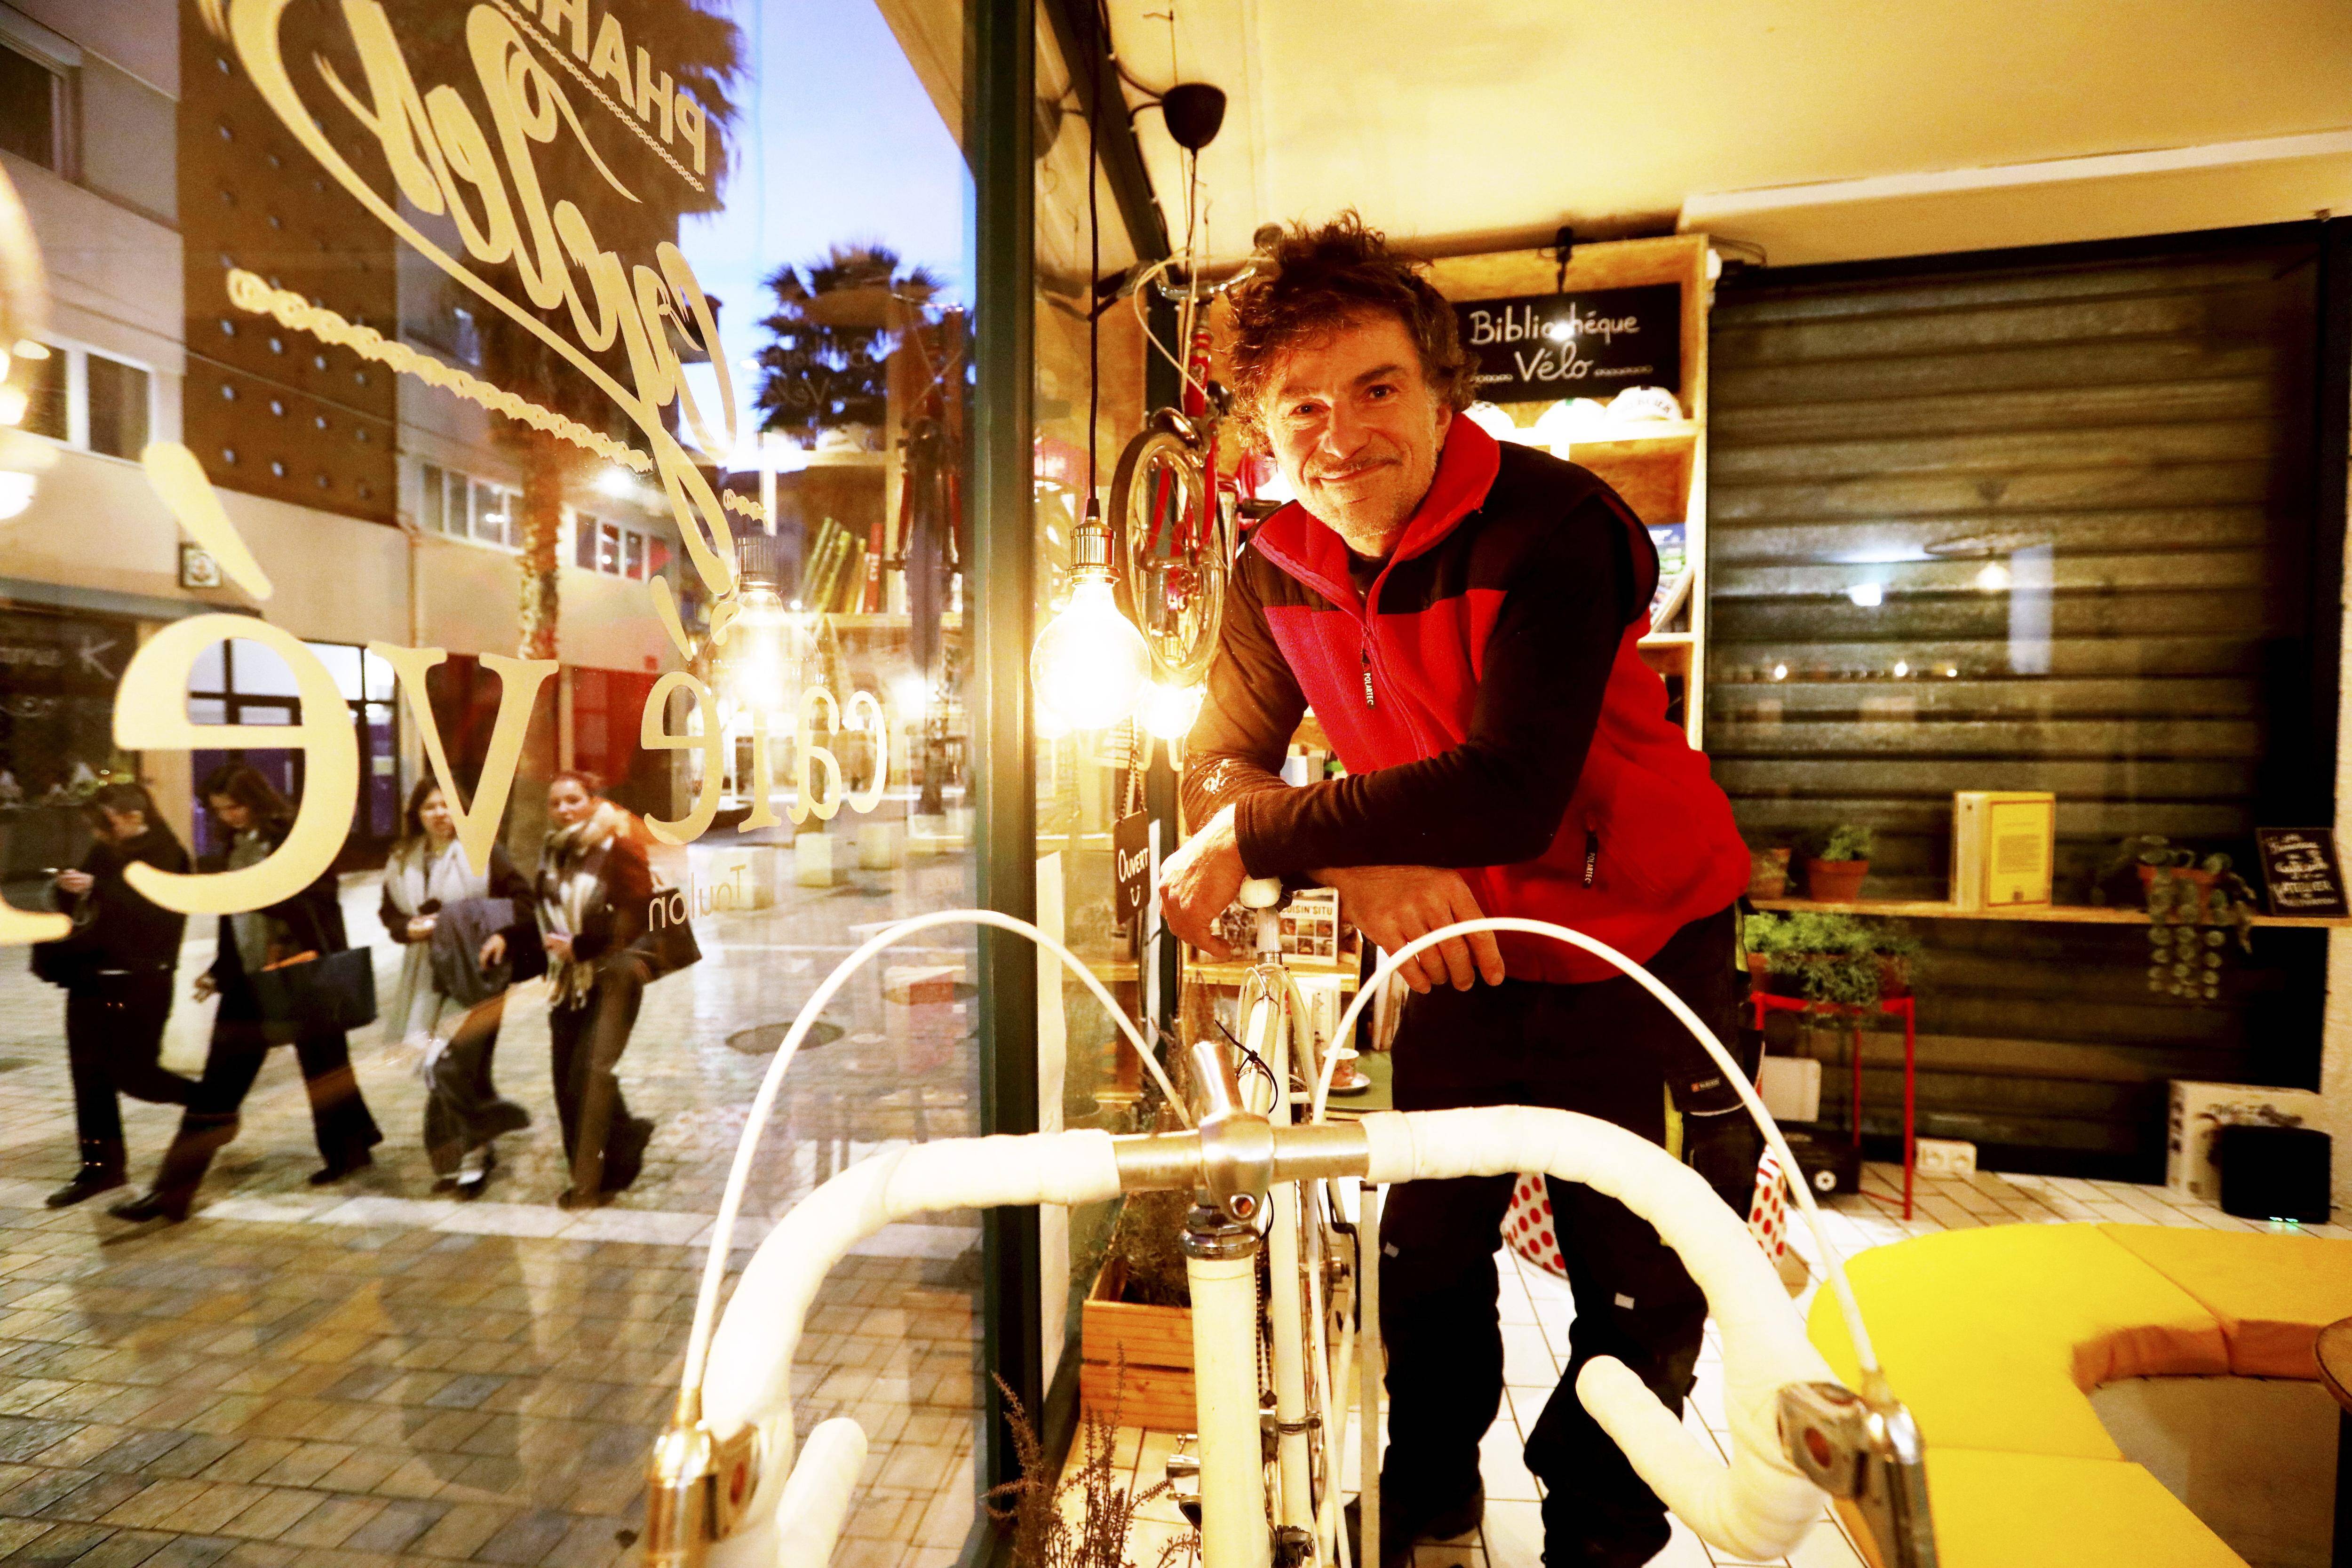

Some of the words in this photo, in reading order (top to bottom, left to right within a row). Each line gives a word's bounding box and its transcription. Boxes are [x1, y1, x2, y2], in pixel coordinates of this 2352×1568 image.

[1469, 302, 1641, 345] Bibliohéque
[1514, 340, 1594, 382] Vélo
[1364, 672, 1374, 705] POLARTEC
[1584, 852, 1596, 883] POLARTEC
[1281, 905, 1333, 915] UISIN'SITU
